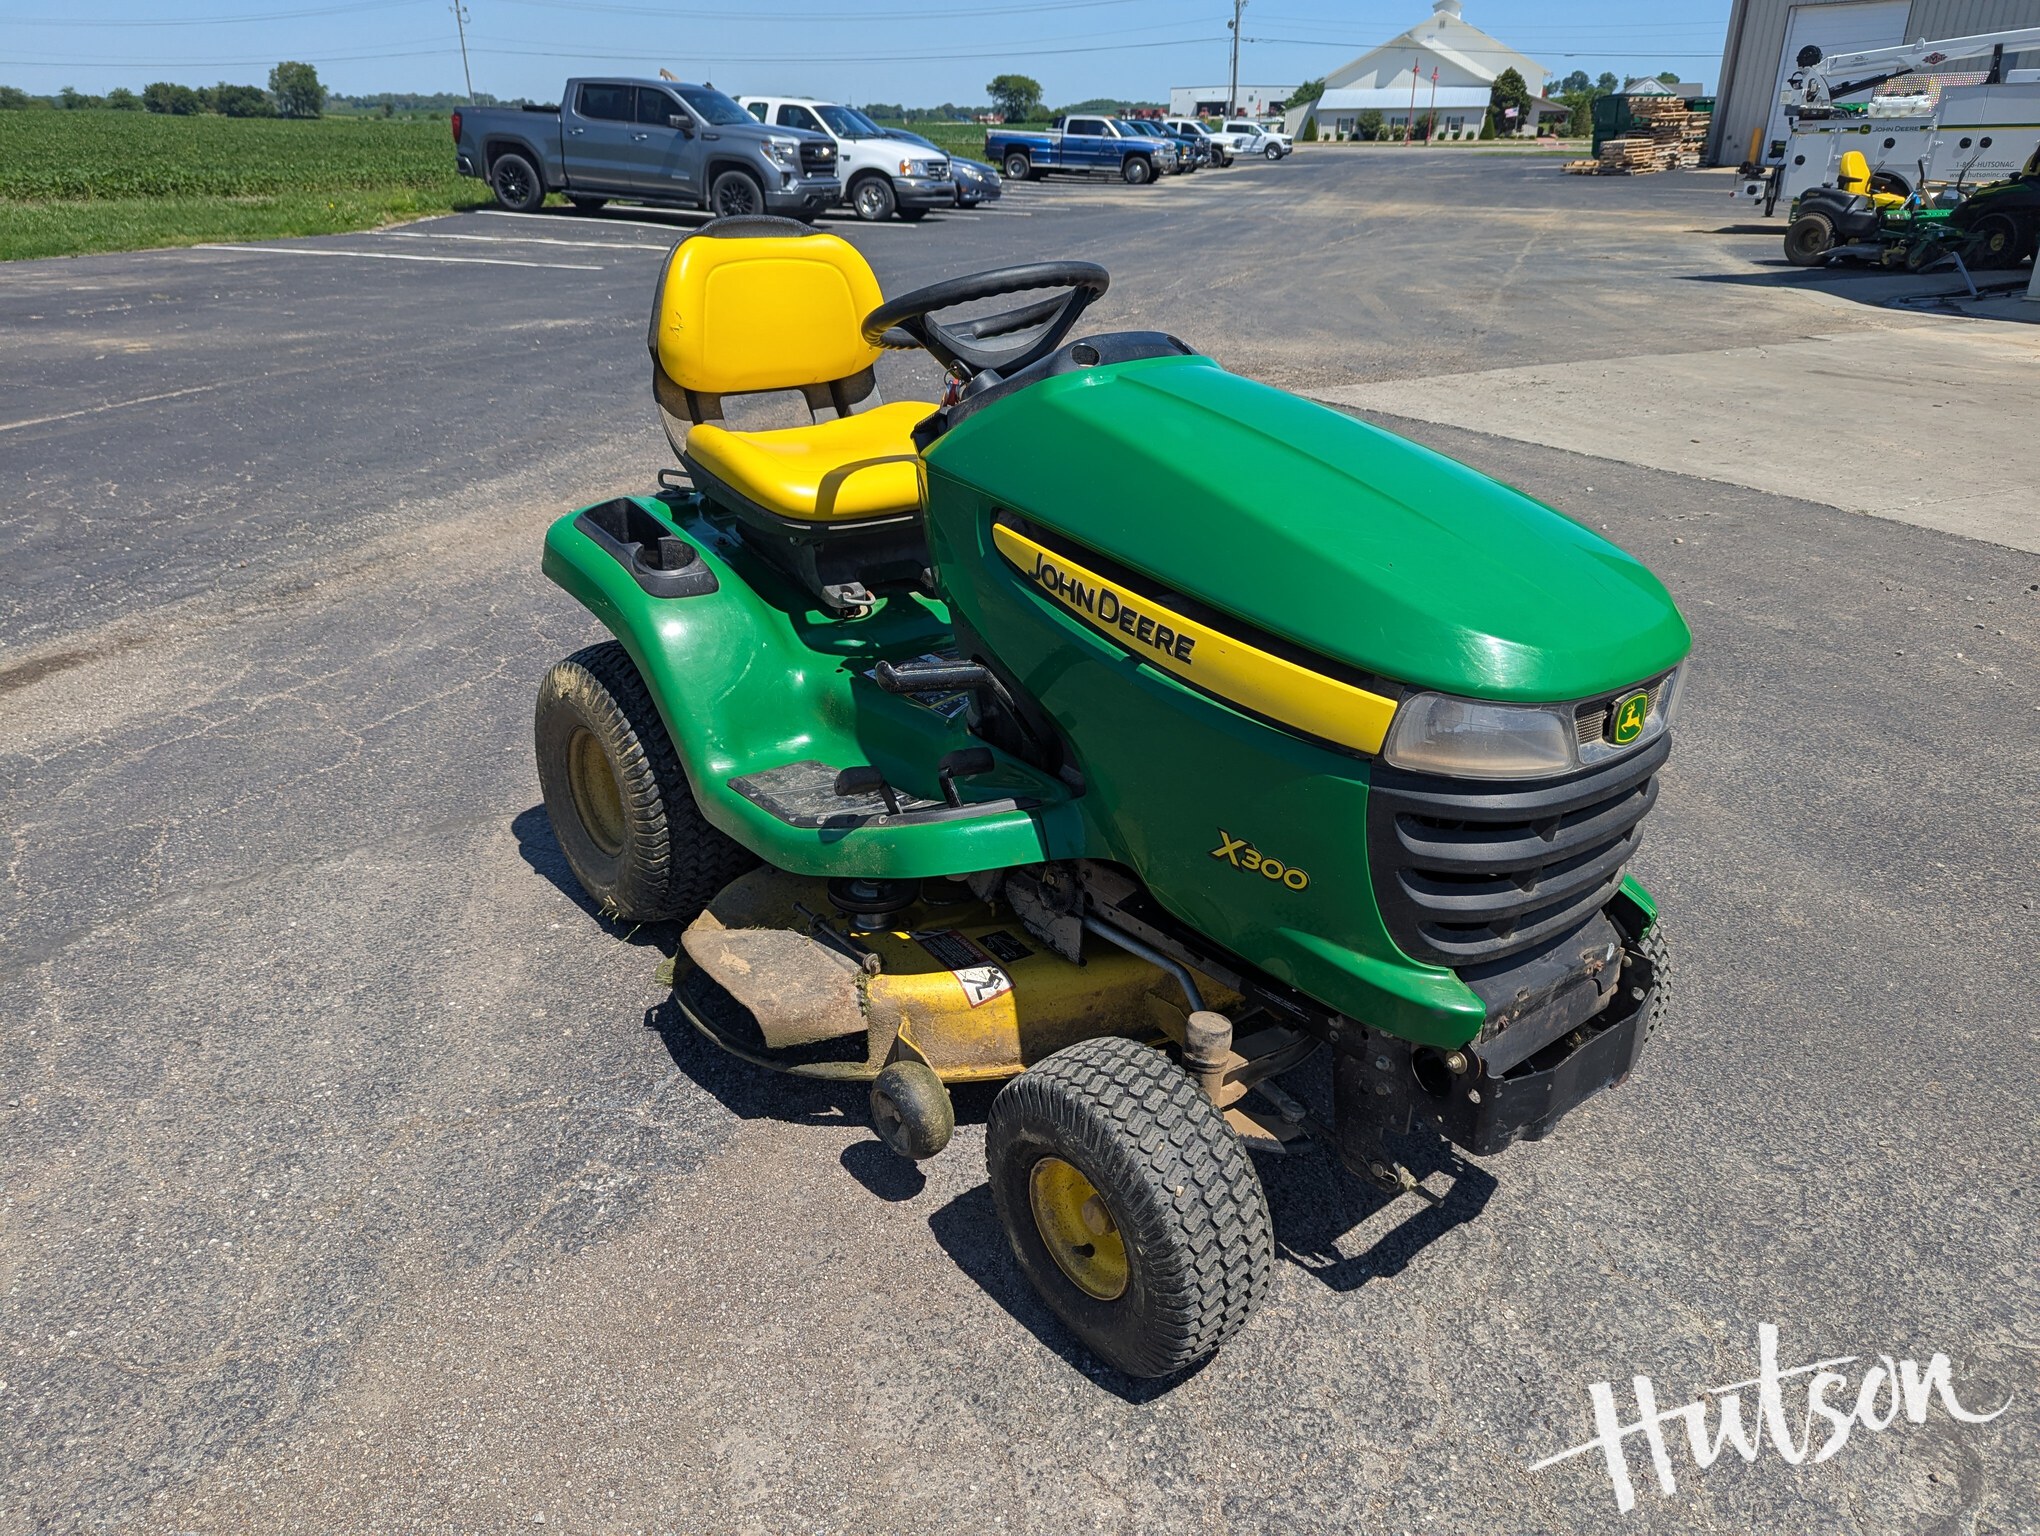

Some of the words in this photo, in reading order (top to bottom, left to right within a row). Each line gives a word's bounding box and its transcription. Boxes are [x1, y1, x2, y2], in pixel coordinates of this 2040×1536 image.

[1028, 552, 1095, 614] JOHN
[1098, 588, 1196, 665] DEERE
[1208, 827, 1310, 892] X300
